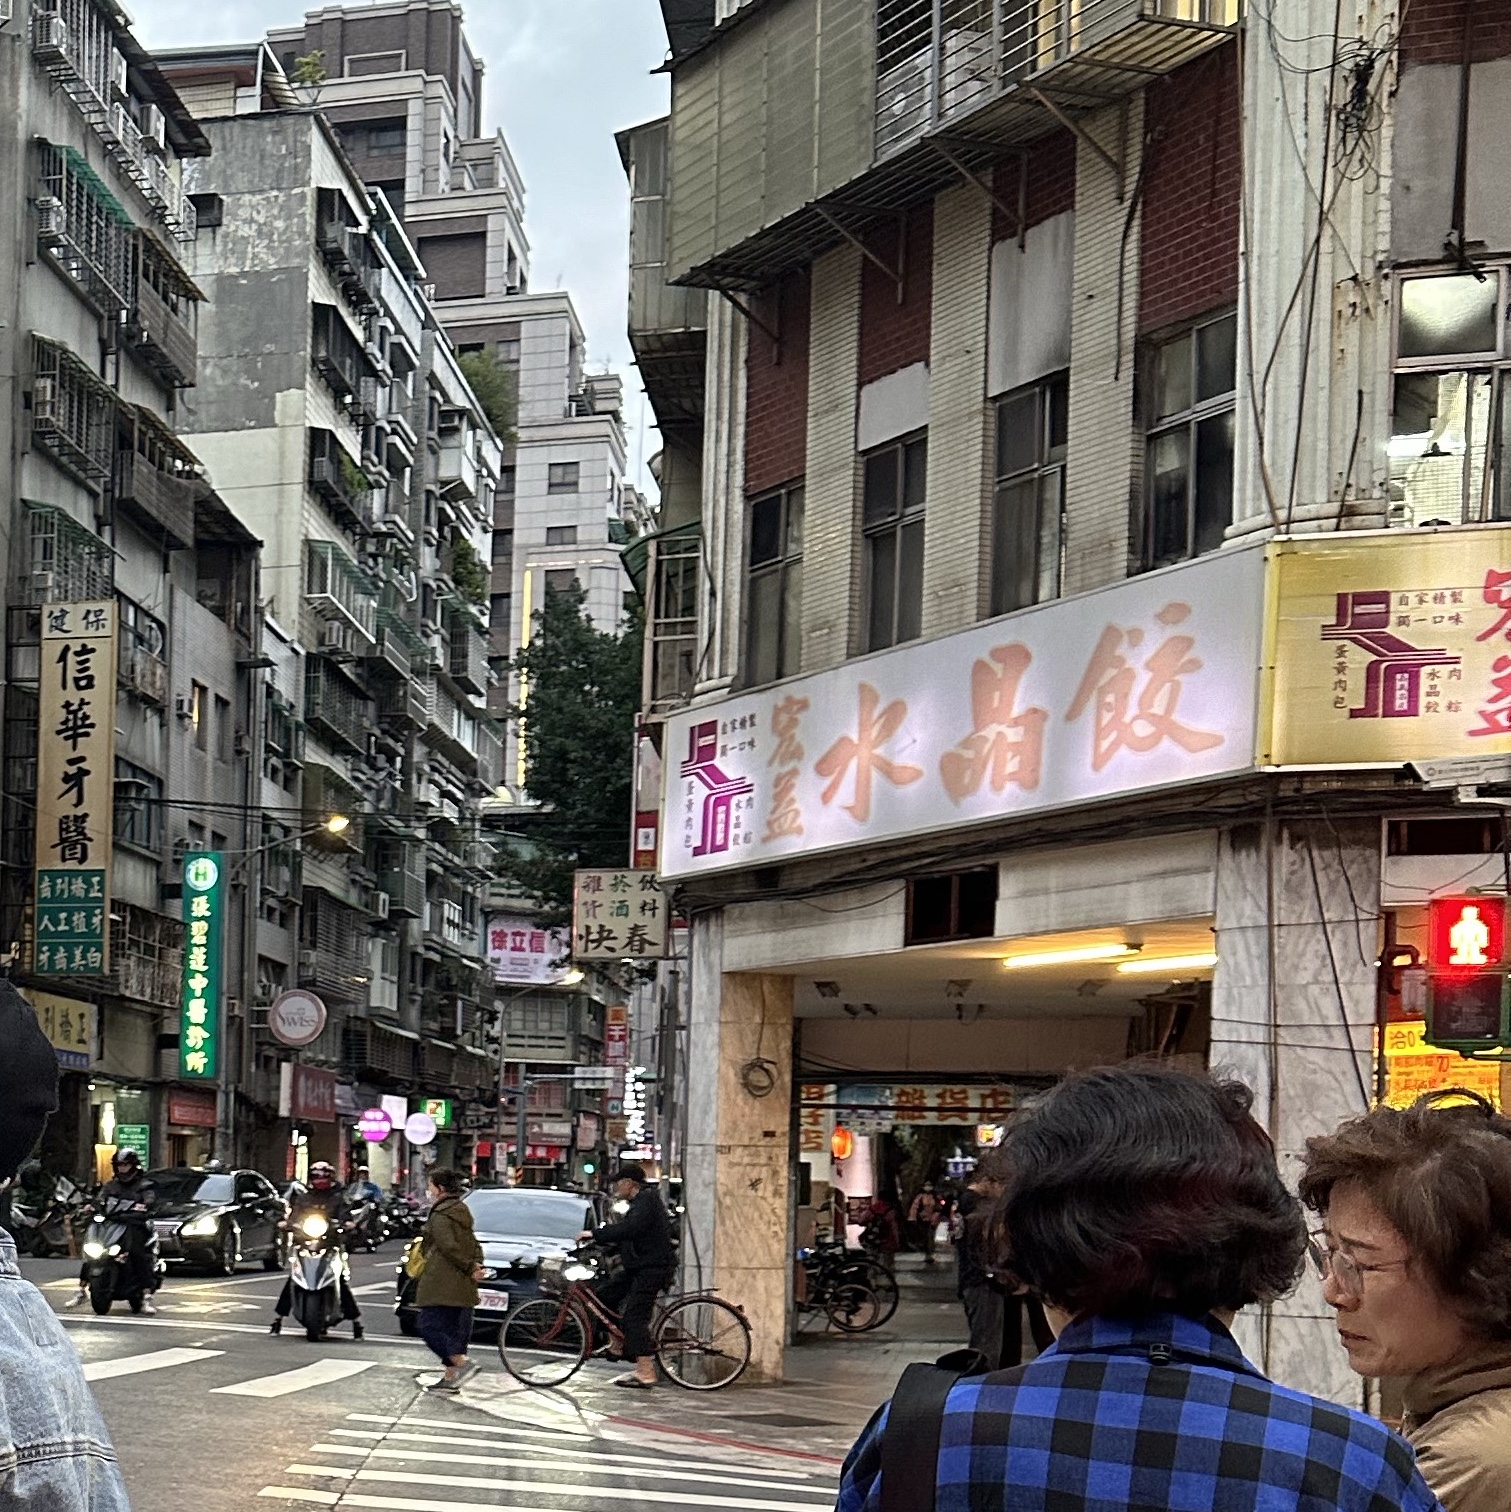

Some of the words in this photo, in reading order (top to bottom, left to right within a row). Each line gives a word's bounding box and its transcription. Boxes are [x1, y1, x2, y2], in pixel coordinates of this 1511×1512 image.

[1398, 590, 1463, 606] 自家精製
[47, 608, 108, 634] 健保
[814, 601, 1226, 823] 水晶餃
[50, 643, 97, 866] 信華牙醫
[39, 909, 103, 935] 人工植牙
